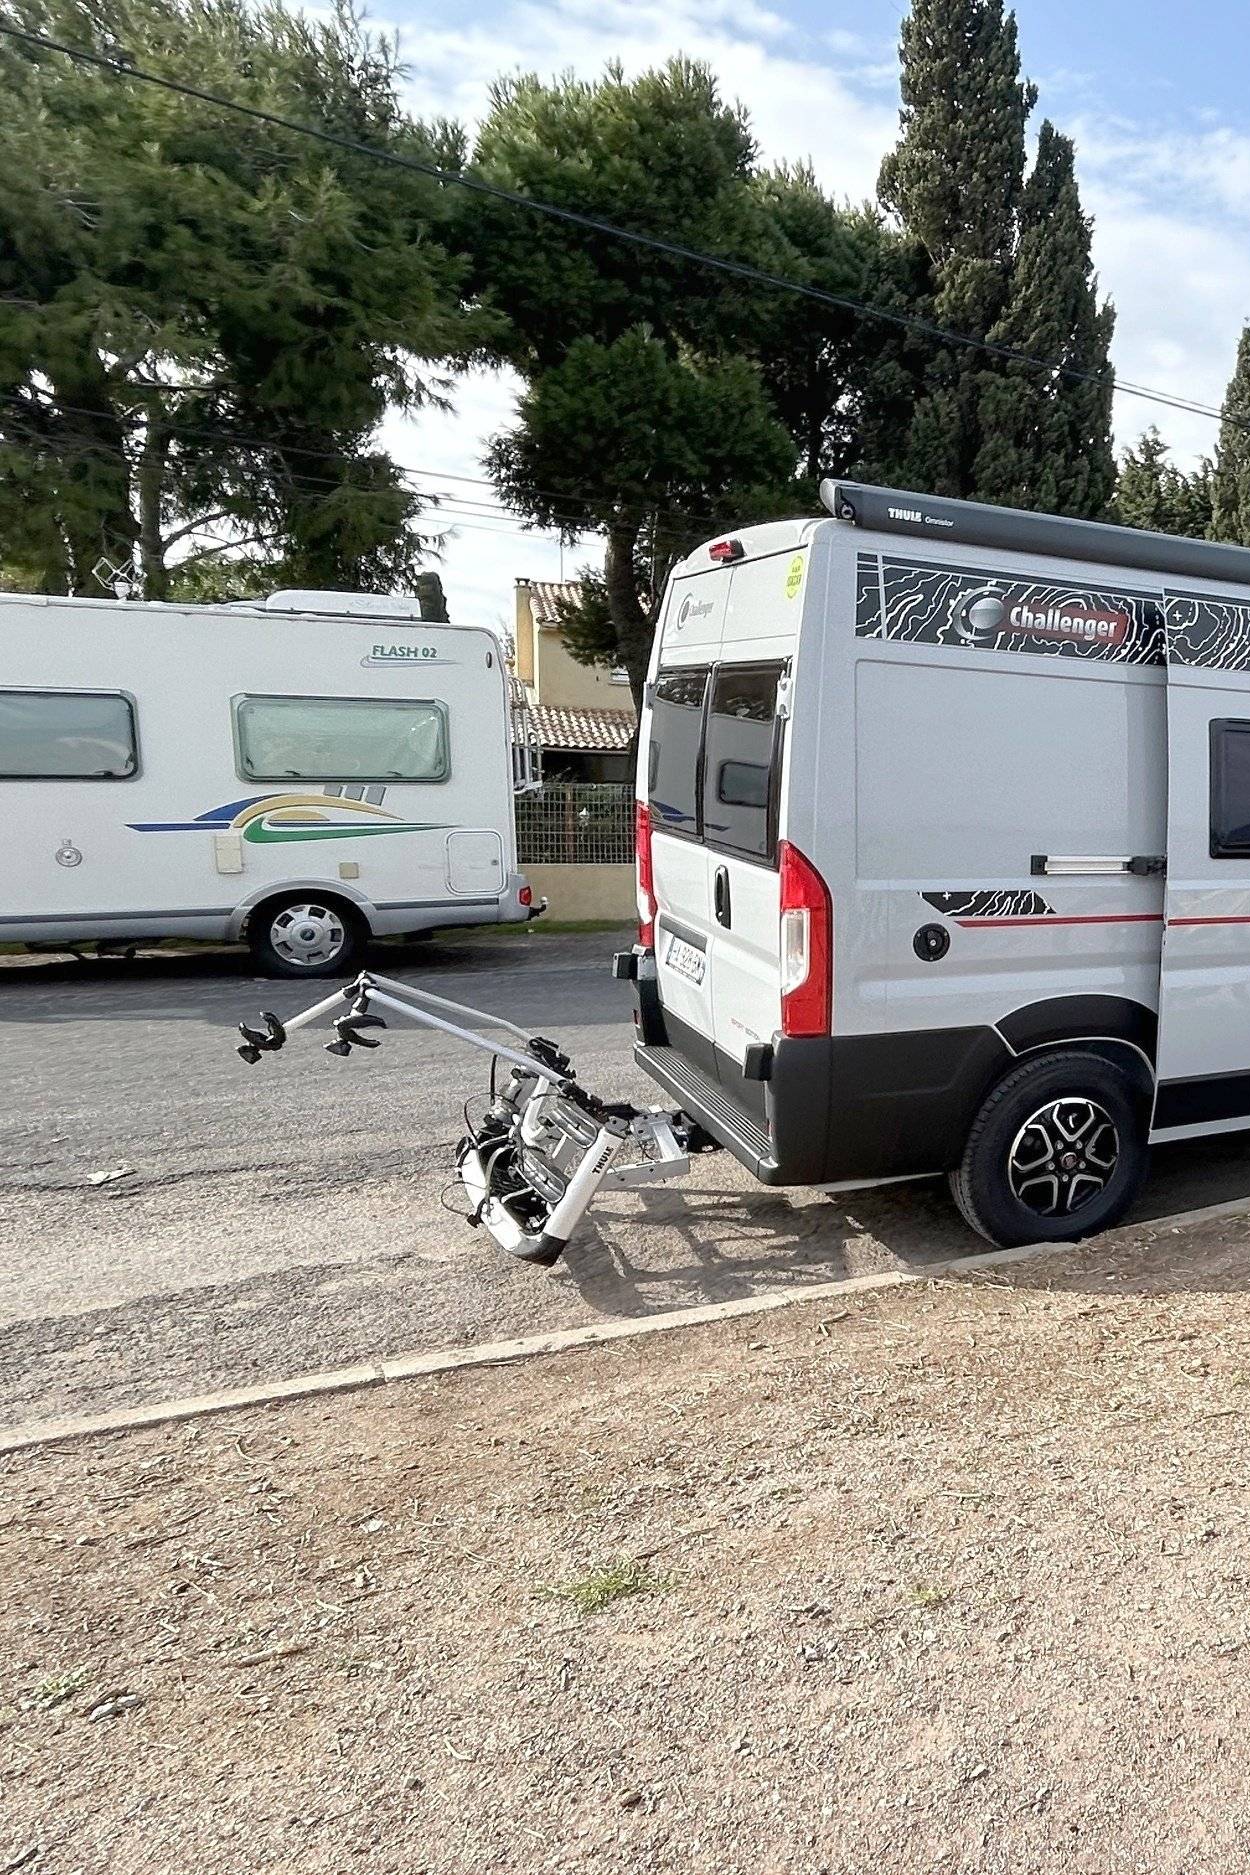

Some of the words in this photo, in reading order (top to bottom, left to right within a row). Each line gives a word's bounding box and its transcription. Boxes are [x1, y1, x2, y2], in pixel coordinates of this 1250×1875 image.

[887, 507, 922, 523] THULE
[1010, 605, 1118, 641] Challenger
[372, 645, 419, 658] FLASH
[421, 647, 438, 659] 02
[592, 1146, 614, 1174] THULE
